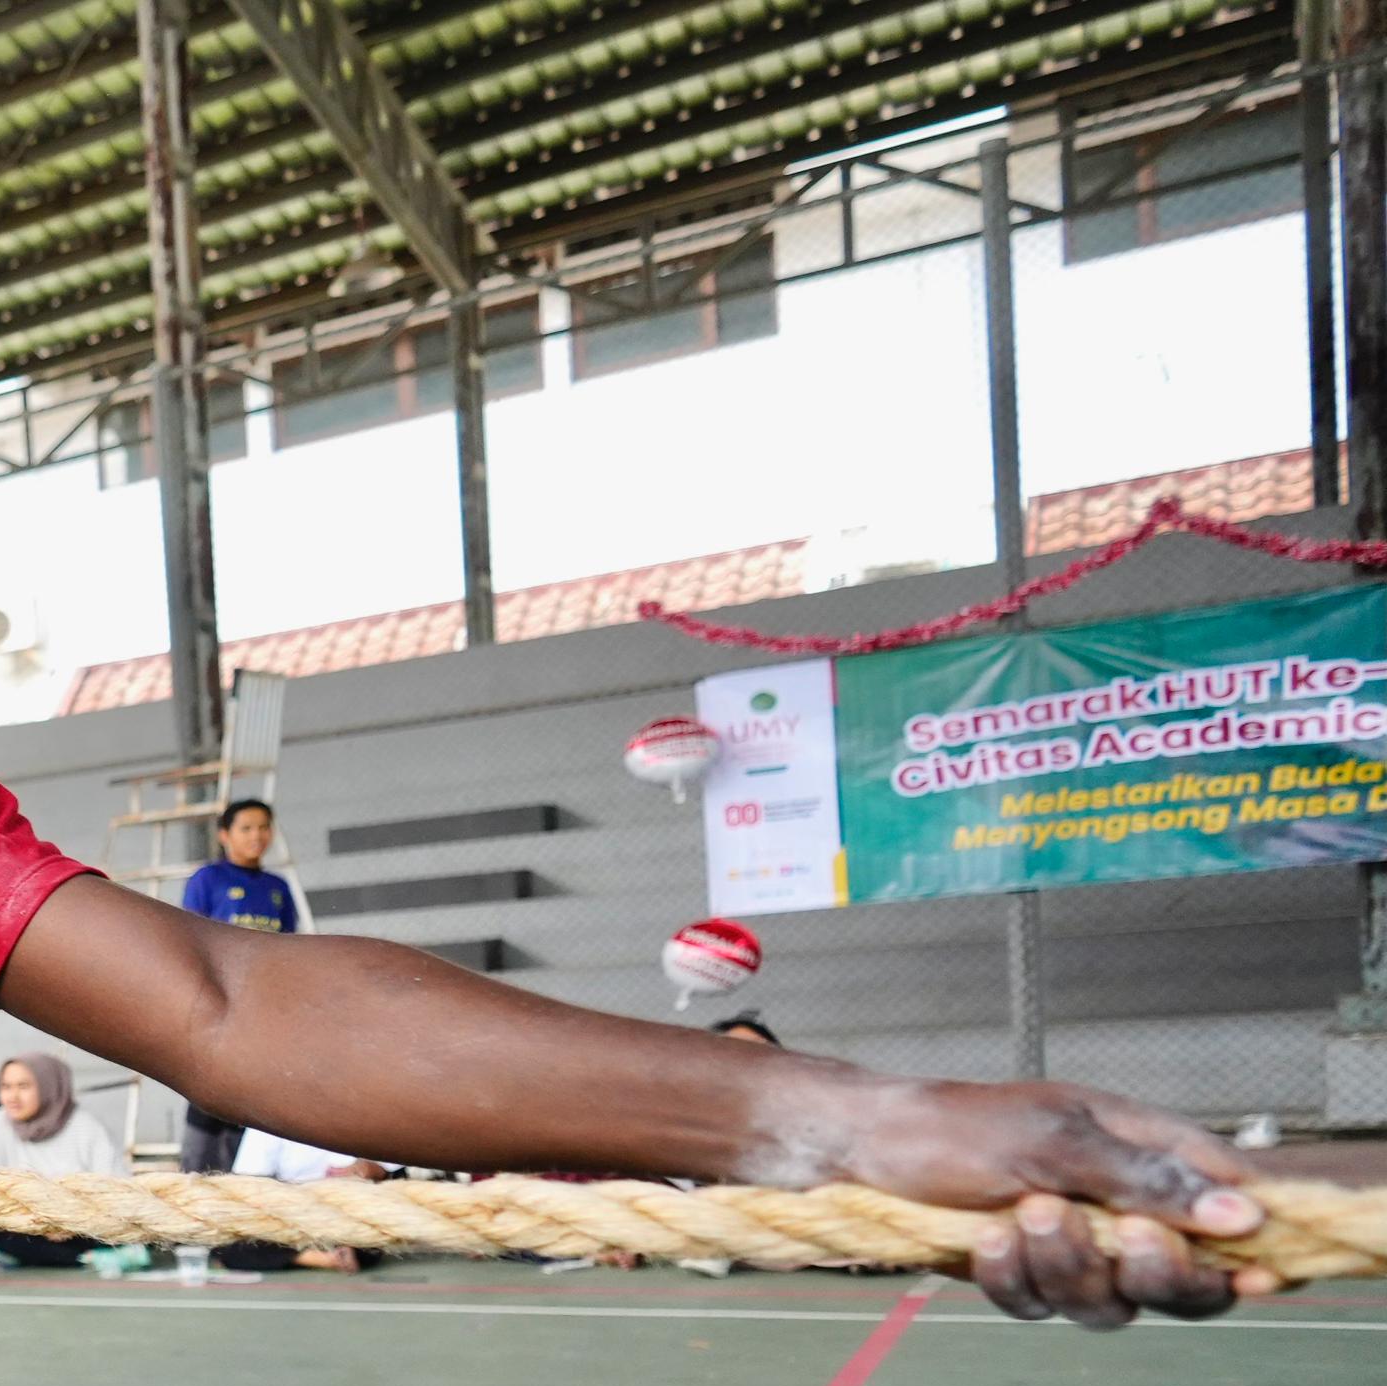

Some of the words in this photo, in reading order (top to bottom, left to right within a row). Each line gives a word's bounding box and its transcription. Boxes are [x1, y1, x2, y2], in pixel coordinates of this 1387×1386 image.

[909, 682, 1148, 748] Semarak
[1162, 666, 1273, 705] HUT
[896, 741, 1075, 793] Civitas
[999, 771, 1262, 818] Melestarikan
[952, 801, 1232, 851] Menyongsong
[1238, 790, 1360, 823] Masa
